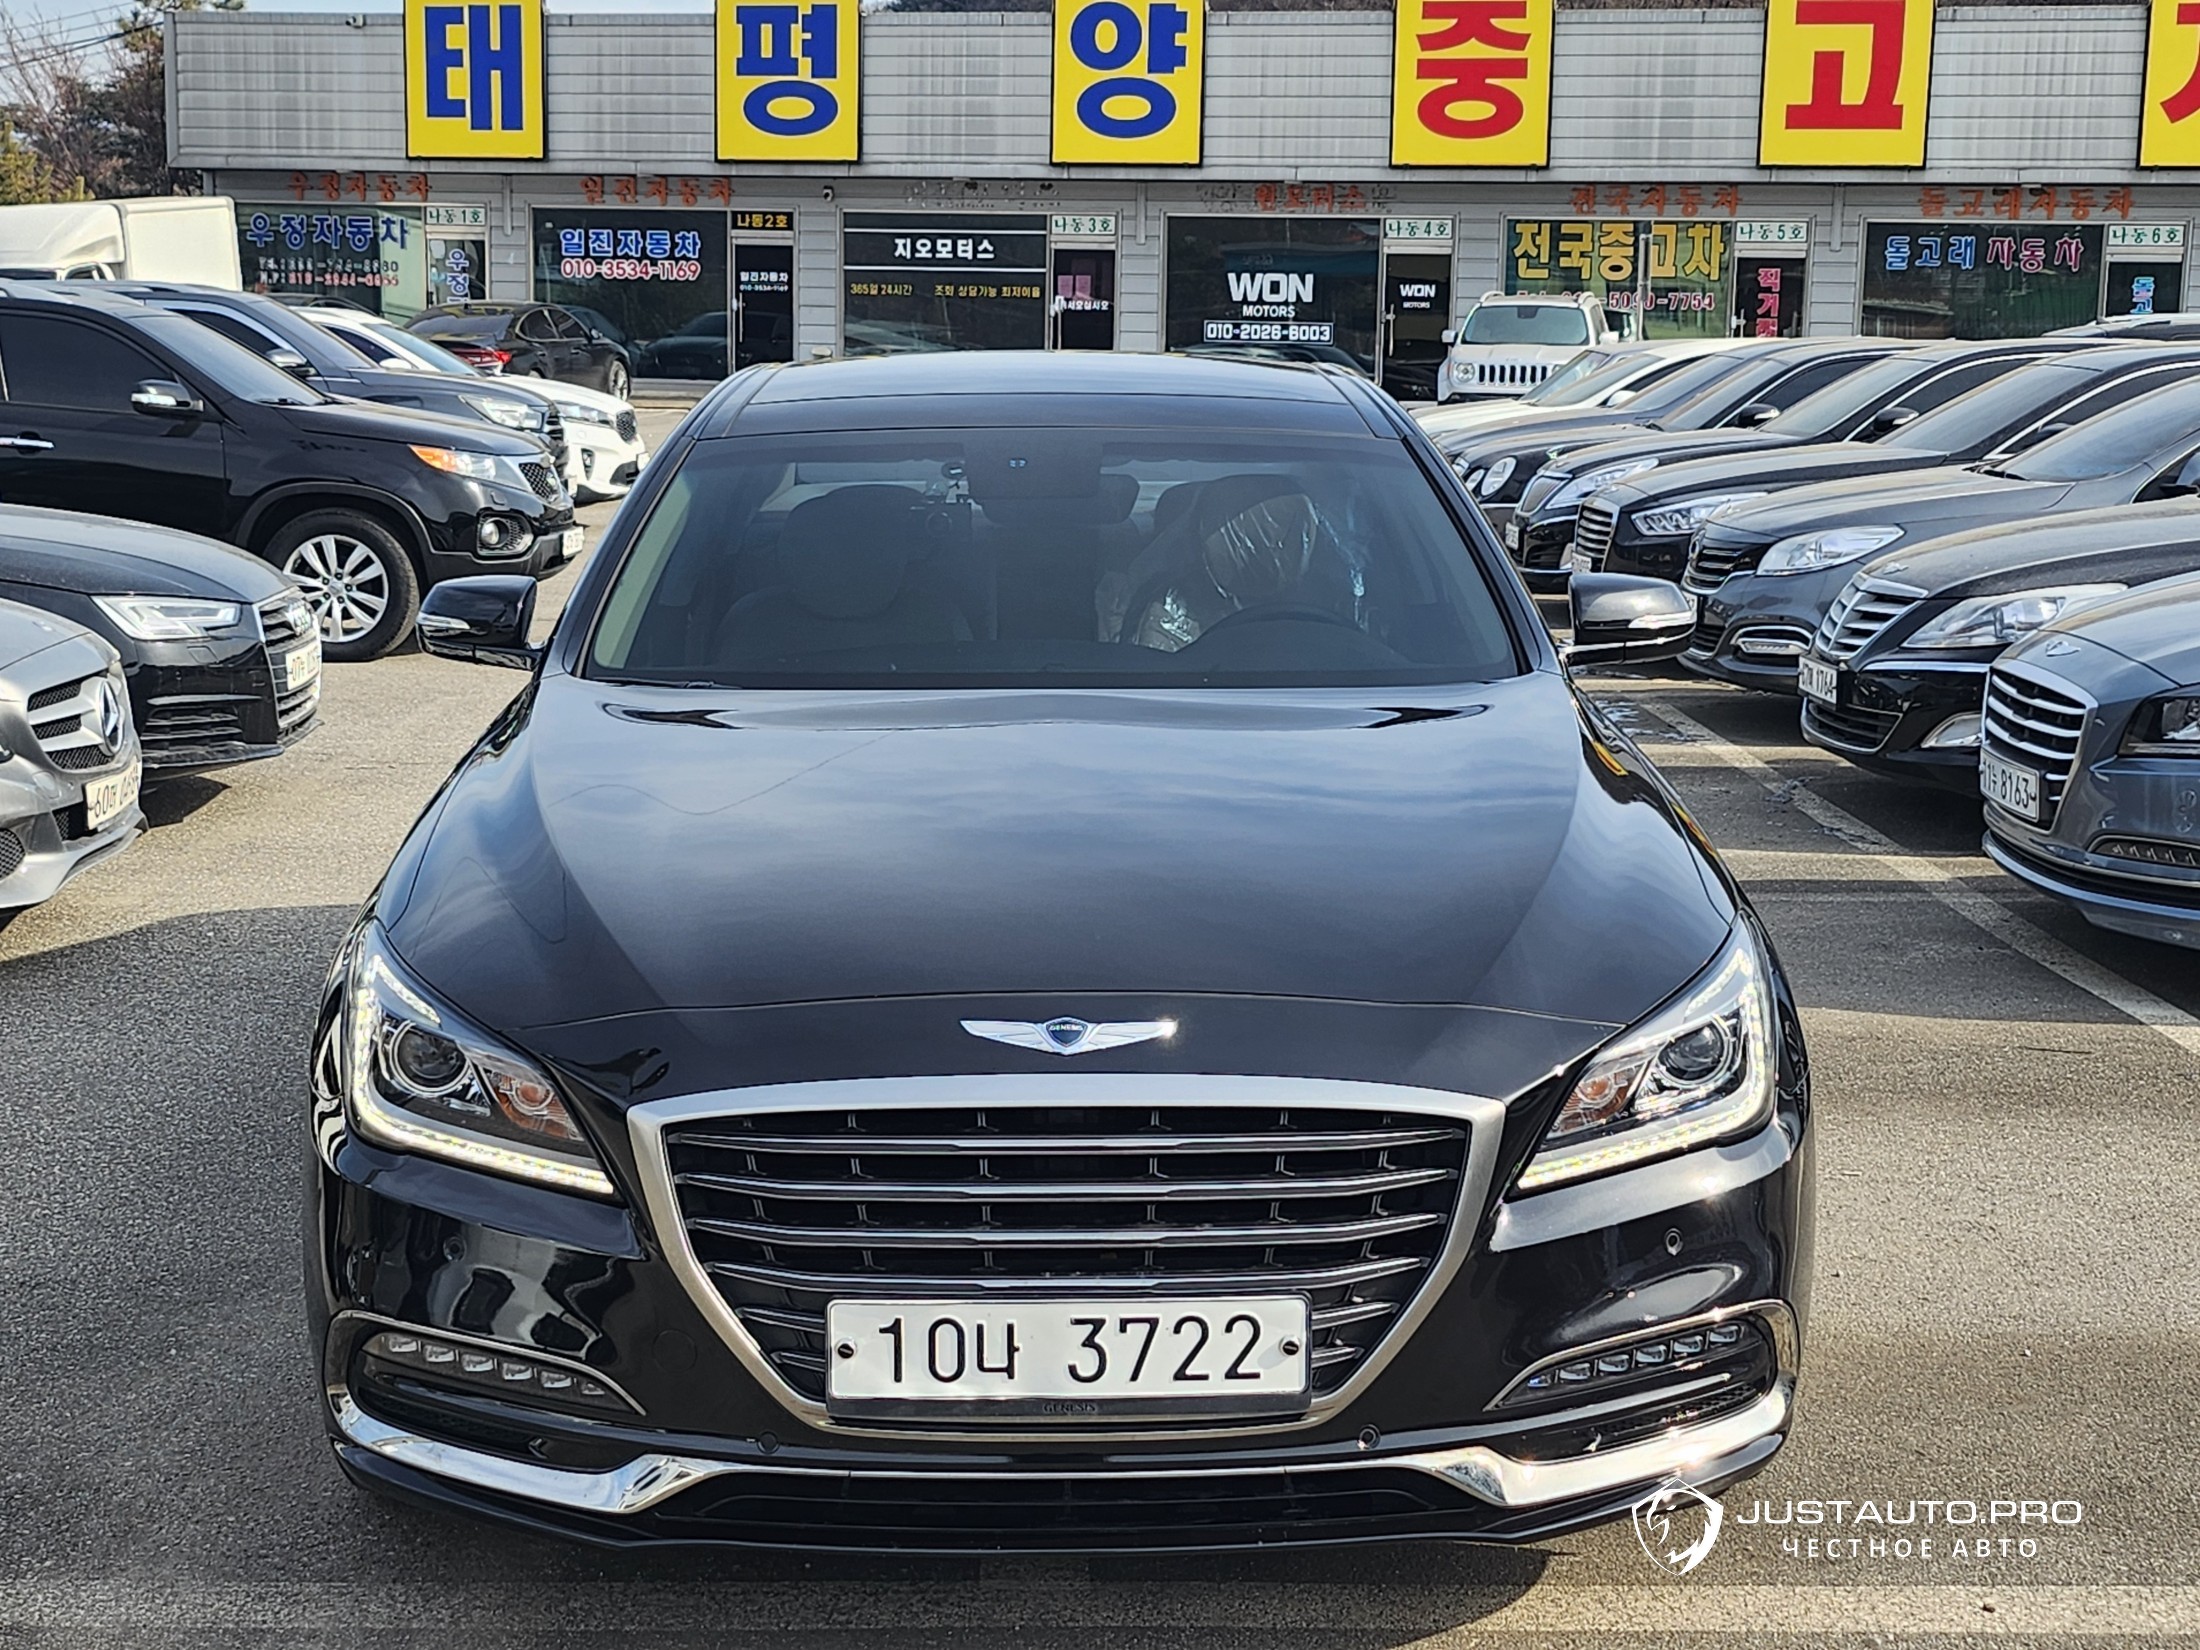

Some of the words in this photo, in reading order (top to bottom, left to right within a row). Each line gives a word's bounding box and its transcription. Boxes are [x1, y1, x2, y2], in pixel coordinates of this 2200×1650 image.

[426, 5, 524, 132] 태
[736, 4, 838, 136] 평
[1071, 3, 1187, 138] 양
[1416, 1, 1531, 139] 중
[1785, 0, 1904, 131] 고
[287, 172, 432, 202] 우정자동차
[580, 176, 735, 206] 일진자동차
[247, 212, 408, 251] 우정자동차
[560, 229, 701, 258] 일진자동차
[894, 238, 995, 261] 지오모터스
[1513, 222, 1725, 281] 전국중고차
[561, 259, 701, 281] 010-3534-1169
[740, 271, 789, 282] 일진자동차
[1227, 272, 1314, 303] WON
[1400, 283, 1436, 298] WON
[1242, 304, 1296, 318] MOTORS
[2001, 767, 2030, 809] 8163
[879, 1316, 1020, 1383] 10나
[1067, 1314, 1262, 1384] 3722
